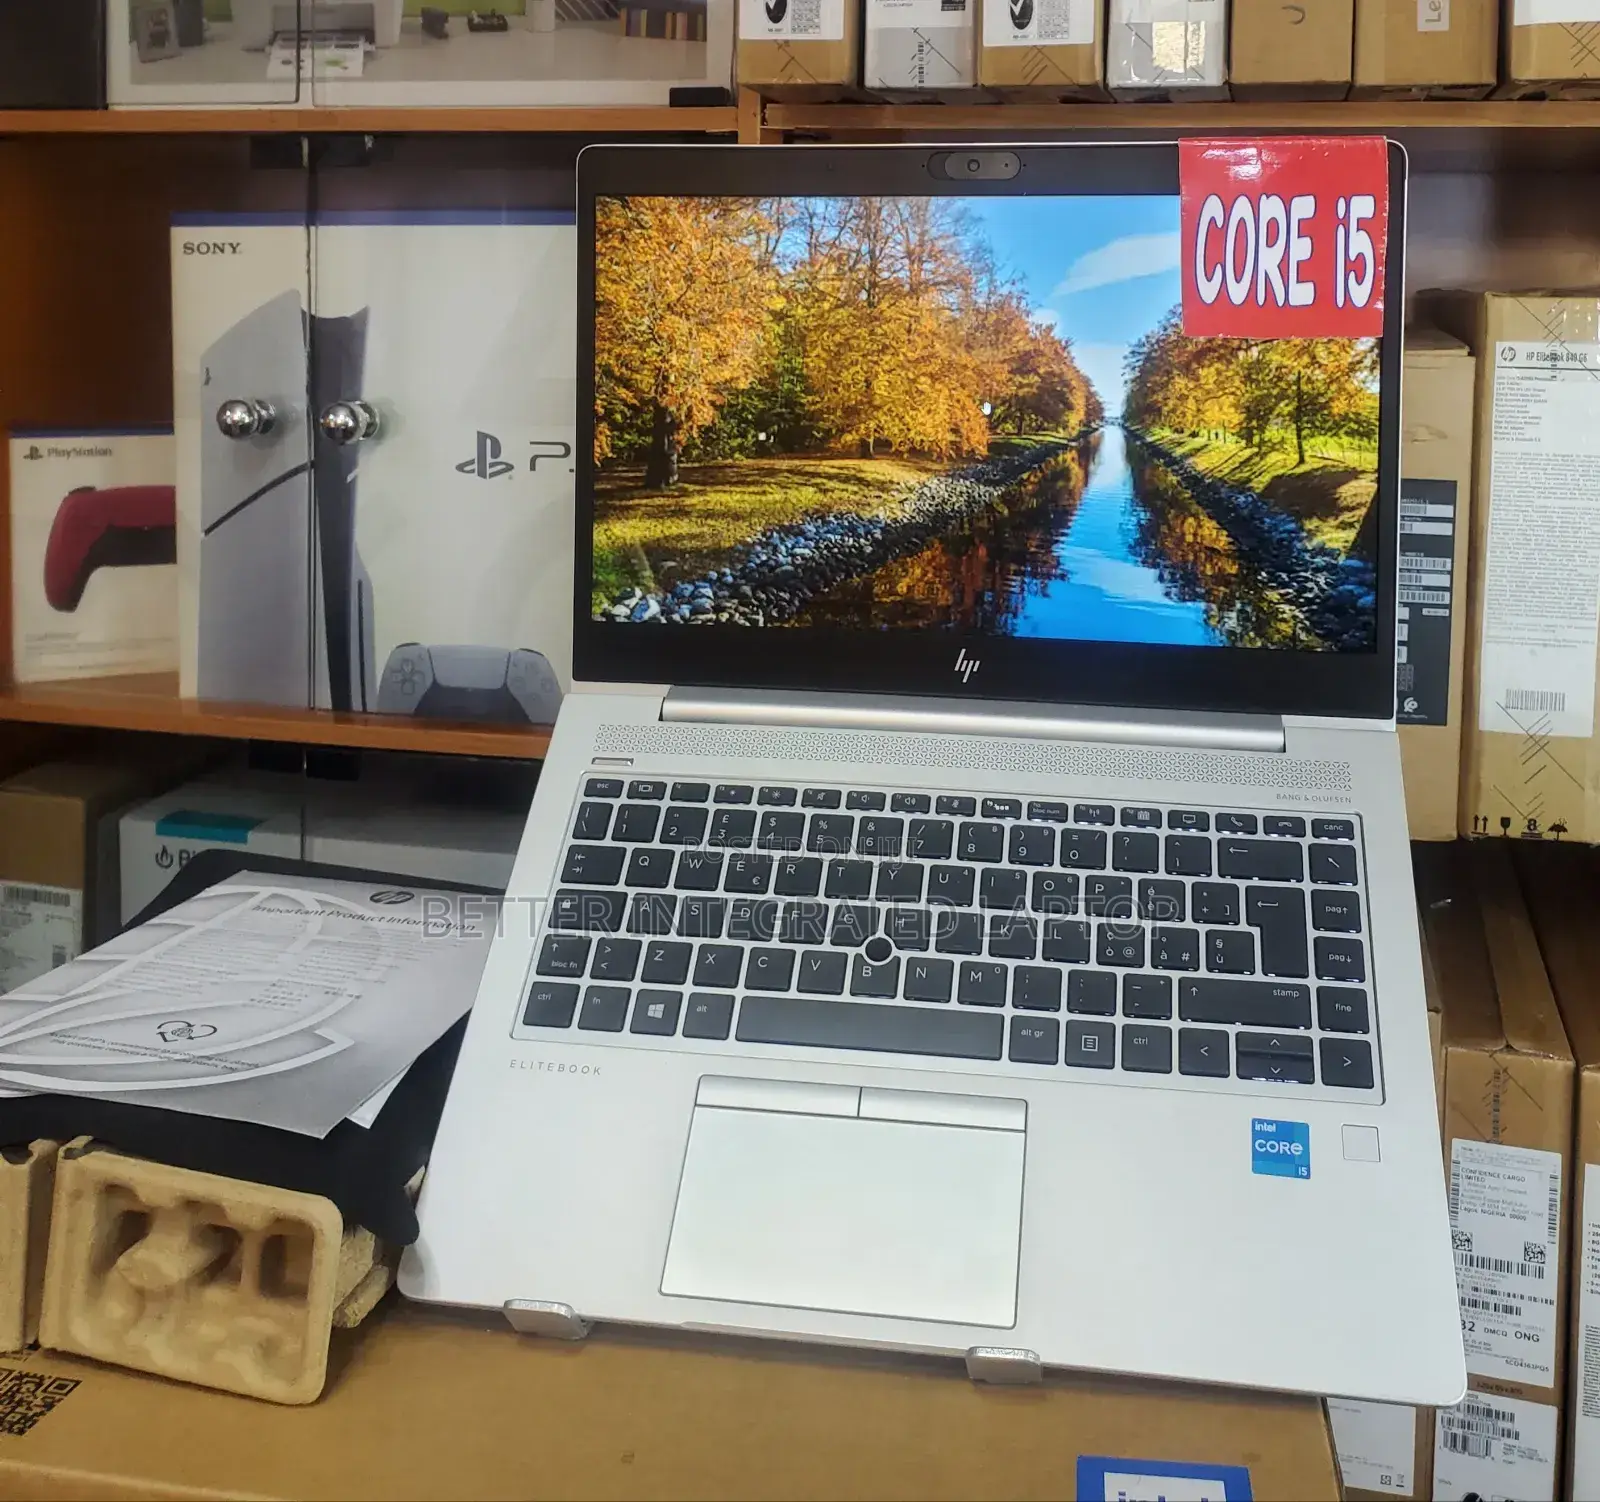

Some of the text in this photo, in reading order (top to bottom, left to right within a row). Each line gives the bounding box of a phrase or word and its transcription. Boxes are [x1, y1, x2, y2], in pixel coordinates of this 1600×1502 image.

[182, 242, 242, 255] SONY
[1195, 193, 1376, 309] CORE i5
[47, 446, 112, 459] PlayStation
[530, 442, 574, 472] P
[1276, 793, 1300, 801] BANG
[722, 815, 729, 823] £
[769, 817, 776, 827] $
[819, 820, 828, 829] %
[867, 822, 875, 831] &
[1324, 824, 1344, 832] canc
[669, 827, 677, 836] 2
[718, 829, 726, 839] 3
[917, 825, 925, 835] /
[816, 835, 824, 844] 5
[866, 837, 874, 846] 6
[917, 840, 924, 849] 7
[1123, 837, 1130, 846] ?
[968, 844, 975, 853] 8
[1019, 847, 1026, 856] 9
[639, 856, 650, 867] Q
[689, 859, 703, 869] W
[737, 862, 746, 871] E
[786, 865, 795, 875] R
[836, 867, 846, 877] T
[888, 870, 898, 880] Y
[752, 876, 761, 885] €
[939, 874, 949, 884] U
[1043, 880, 1055, 892] O
[1095, 883, 1104, 894] P
[640, 902, 650, 912] A
[691, 905, 699, 915] S
[1325, 905, 1342, 914] pag
[741, 907, 750, 918] D
[791, 910, 799, 921] F
[252, 905, 476, 931] Important Product Information
[844, 914, 853, 924] G
[895, 917, 904, 927] H
[1000, 924, 1009, 935] K
[1054, 928, 1061, 939] L
[654, 951, 664, 961] Z
[1123, 947, 1135, 957] @
[1181, 952, 1190, 961] #
[706, 954, 716, 964] X
[758, 957, 768, 968] C
[1216, 954, 1224, 964] ù
[1328, 953, 1345, 963] pag
[551, 960, 578, 969] bloc fn
[811, 960, 821, 971] V
[862, 967, 872, 977] B
[916, 967, 926, 978] N
[970, 971, 982, 982] M
[538, 993, 551, 1001] ctrl
[1273, 988, 1299, 999] stamp
[593, 996, 601, 1004] fn
[696, 1005, 707, 1013] alt
[1335, 1003, 1352, 1012] fine
[1034, 1030, 1044, 1038] gr
[1133, 1036, 1148, 1045] ctrl
[509, 1059, 602, 1076] ELITEBOOK
[1255, 1121, 1276, 1132] intel
[1461, 1167, 1526, 1182] CONFIDENCE CARGO
[1461, 1174, 1486, 1183] LIMITED
[1481, 1208, 1506, 1218] NIGERIA
[1514, 1330, 1540, 1343] ONG
